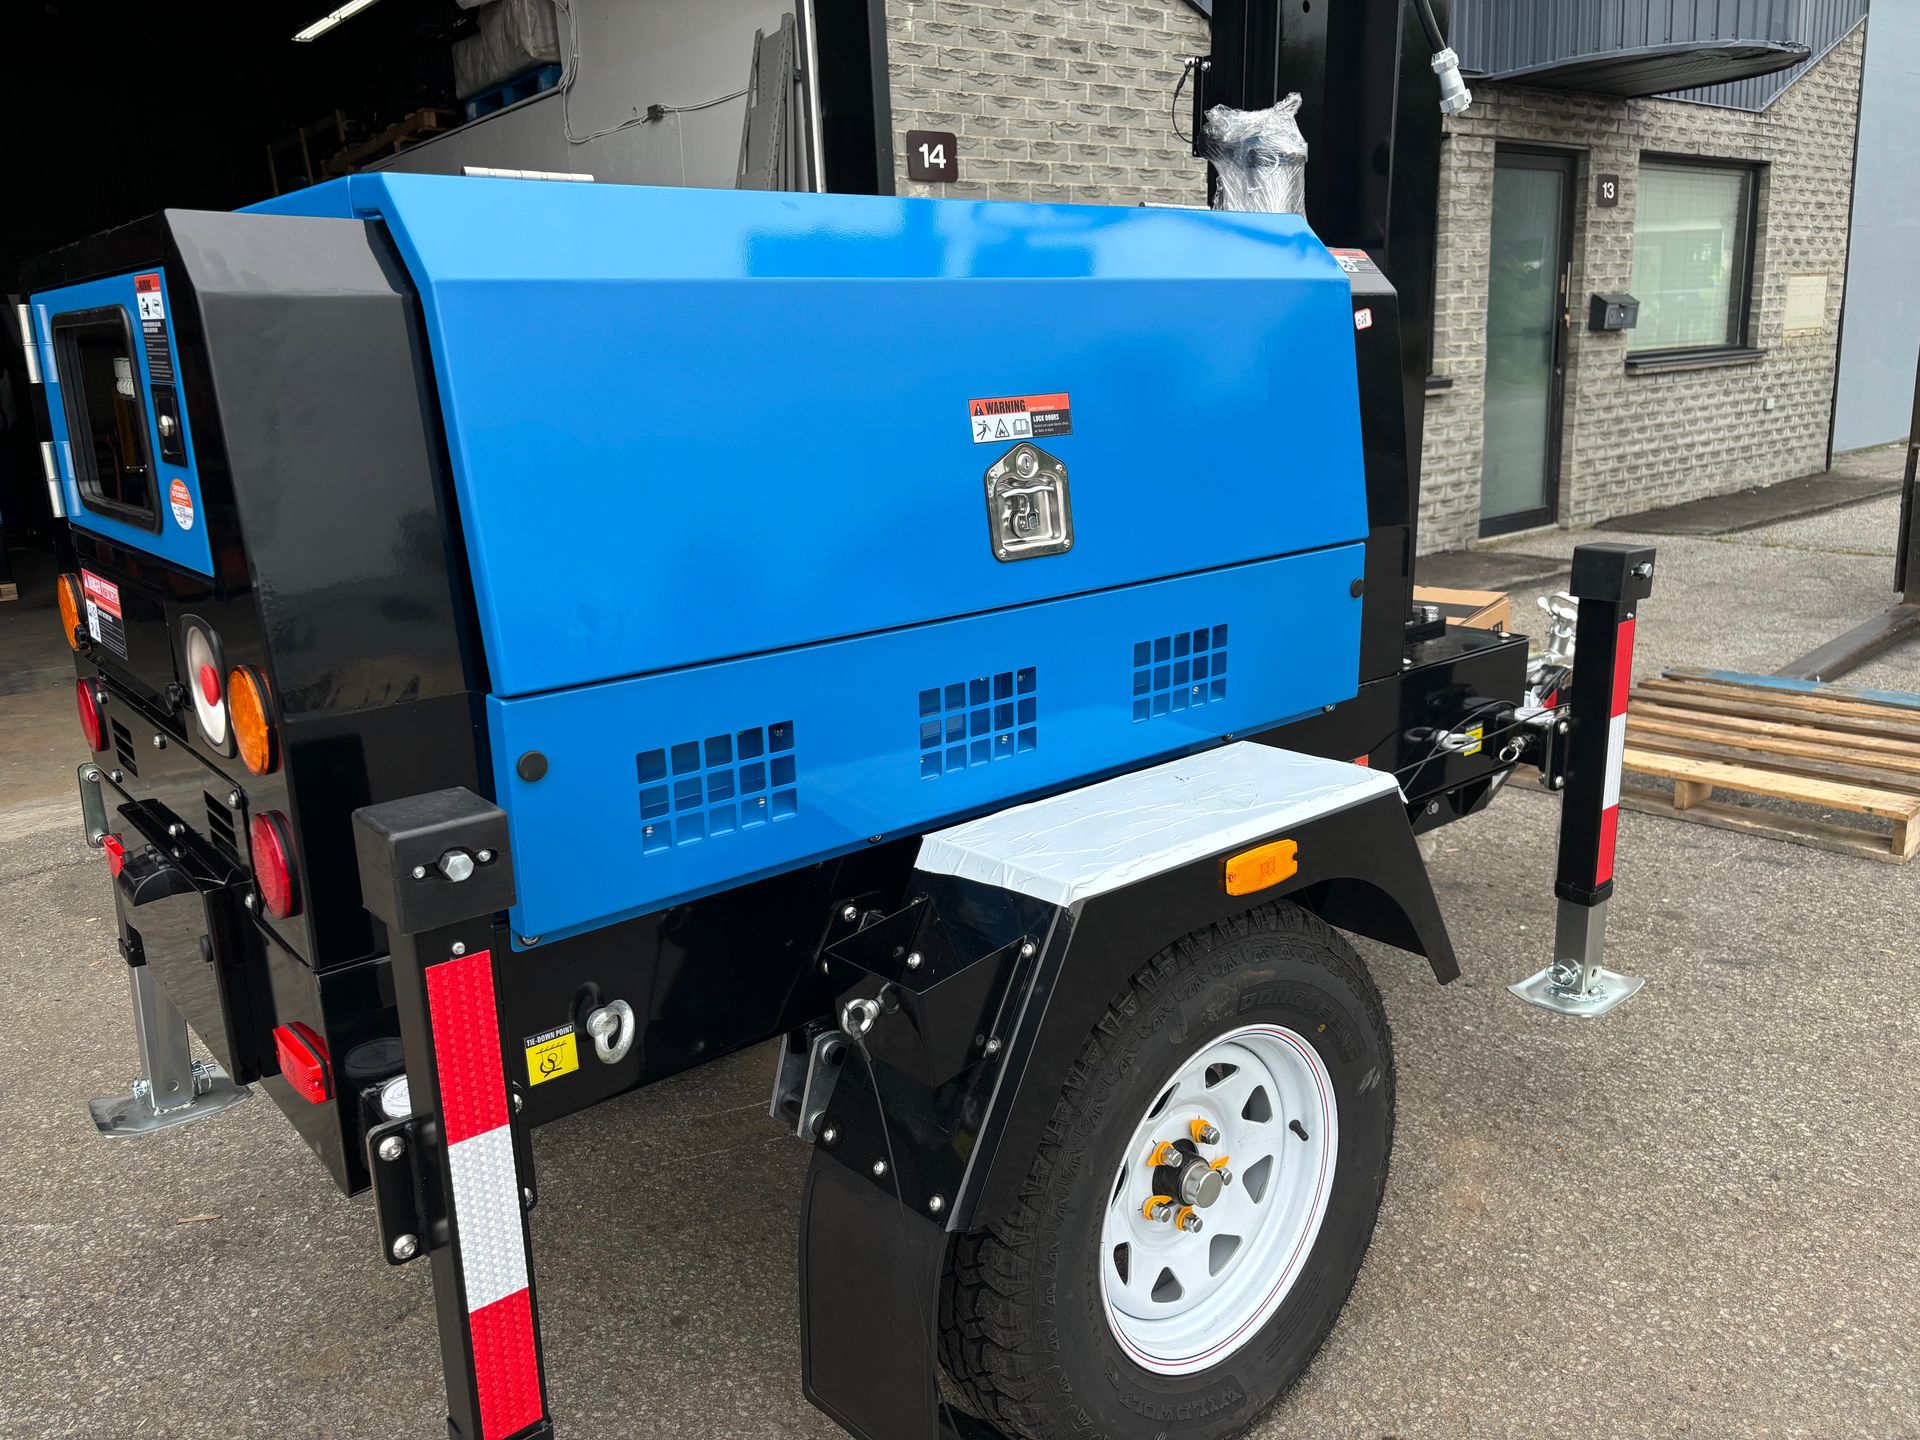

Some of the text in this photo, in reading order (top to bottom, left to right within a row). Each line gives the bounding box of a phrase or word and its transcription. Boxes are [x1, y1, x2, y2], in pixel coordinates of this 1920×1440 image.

[919, 143, 946, 168] 14
[1603, 182, 1614, 198] 13
[985, 400, 1026, 414] WARNING
[526, 1025, 573, 1047] TIE-DOWN POINT
